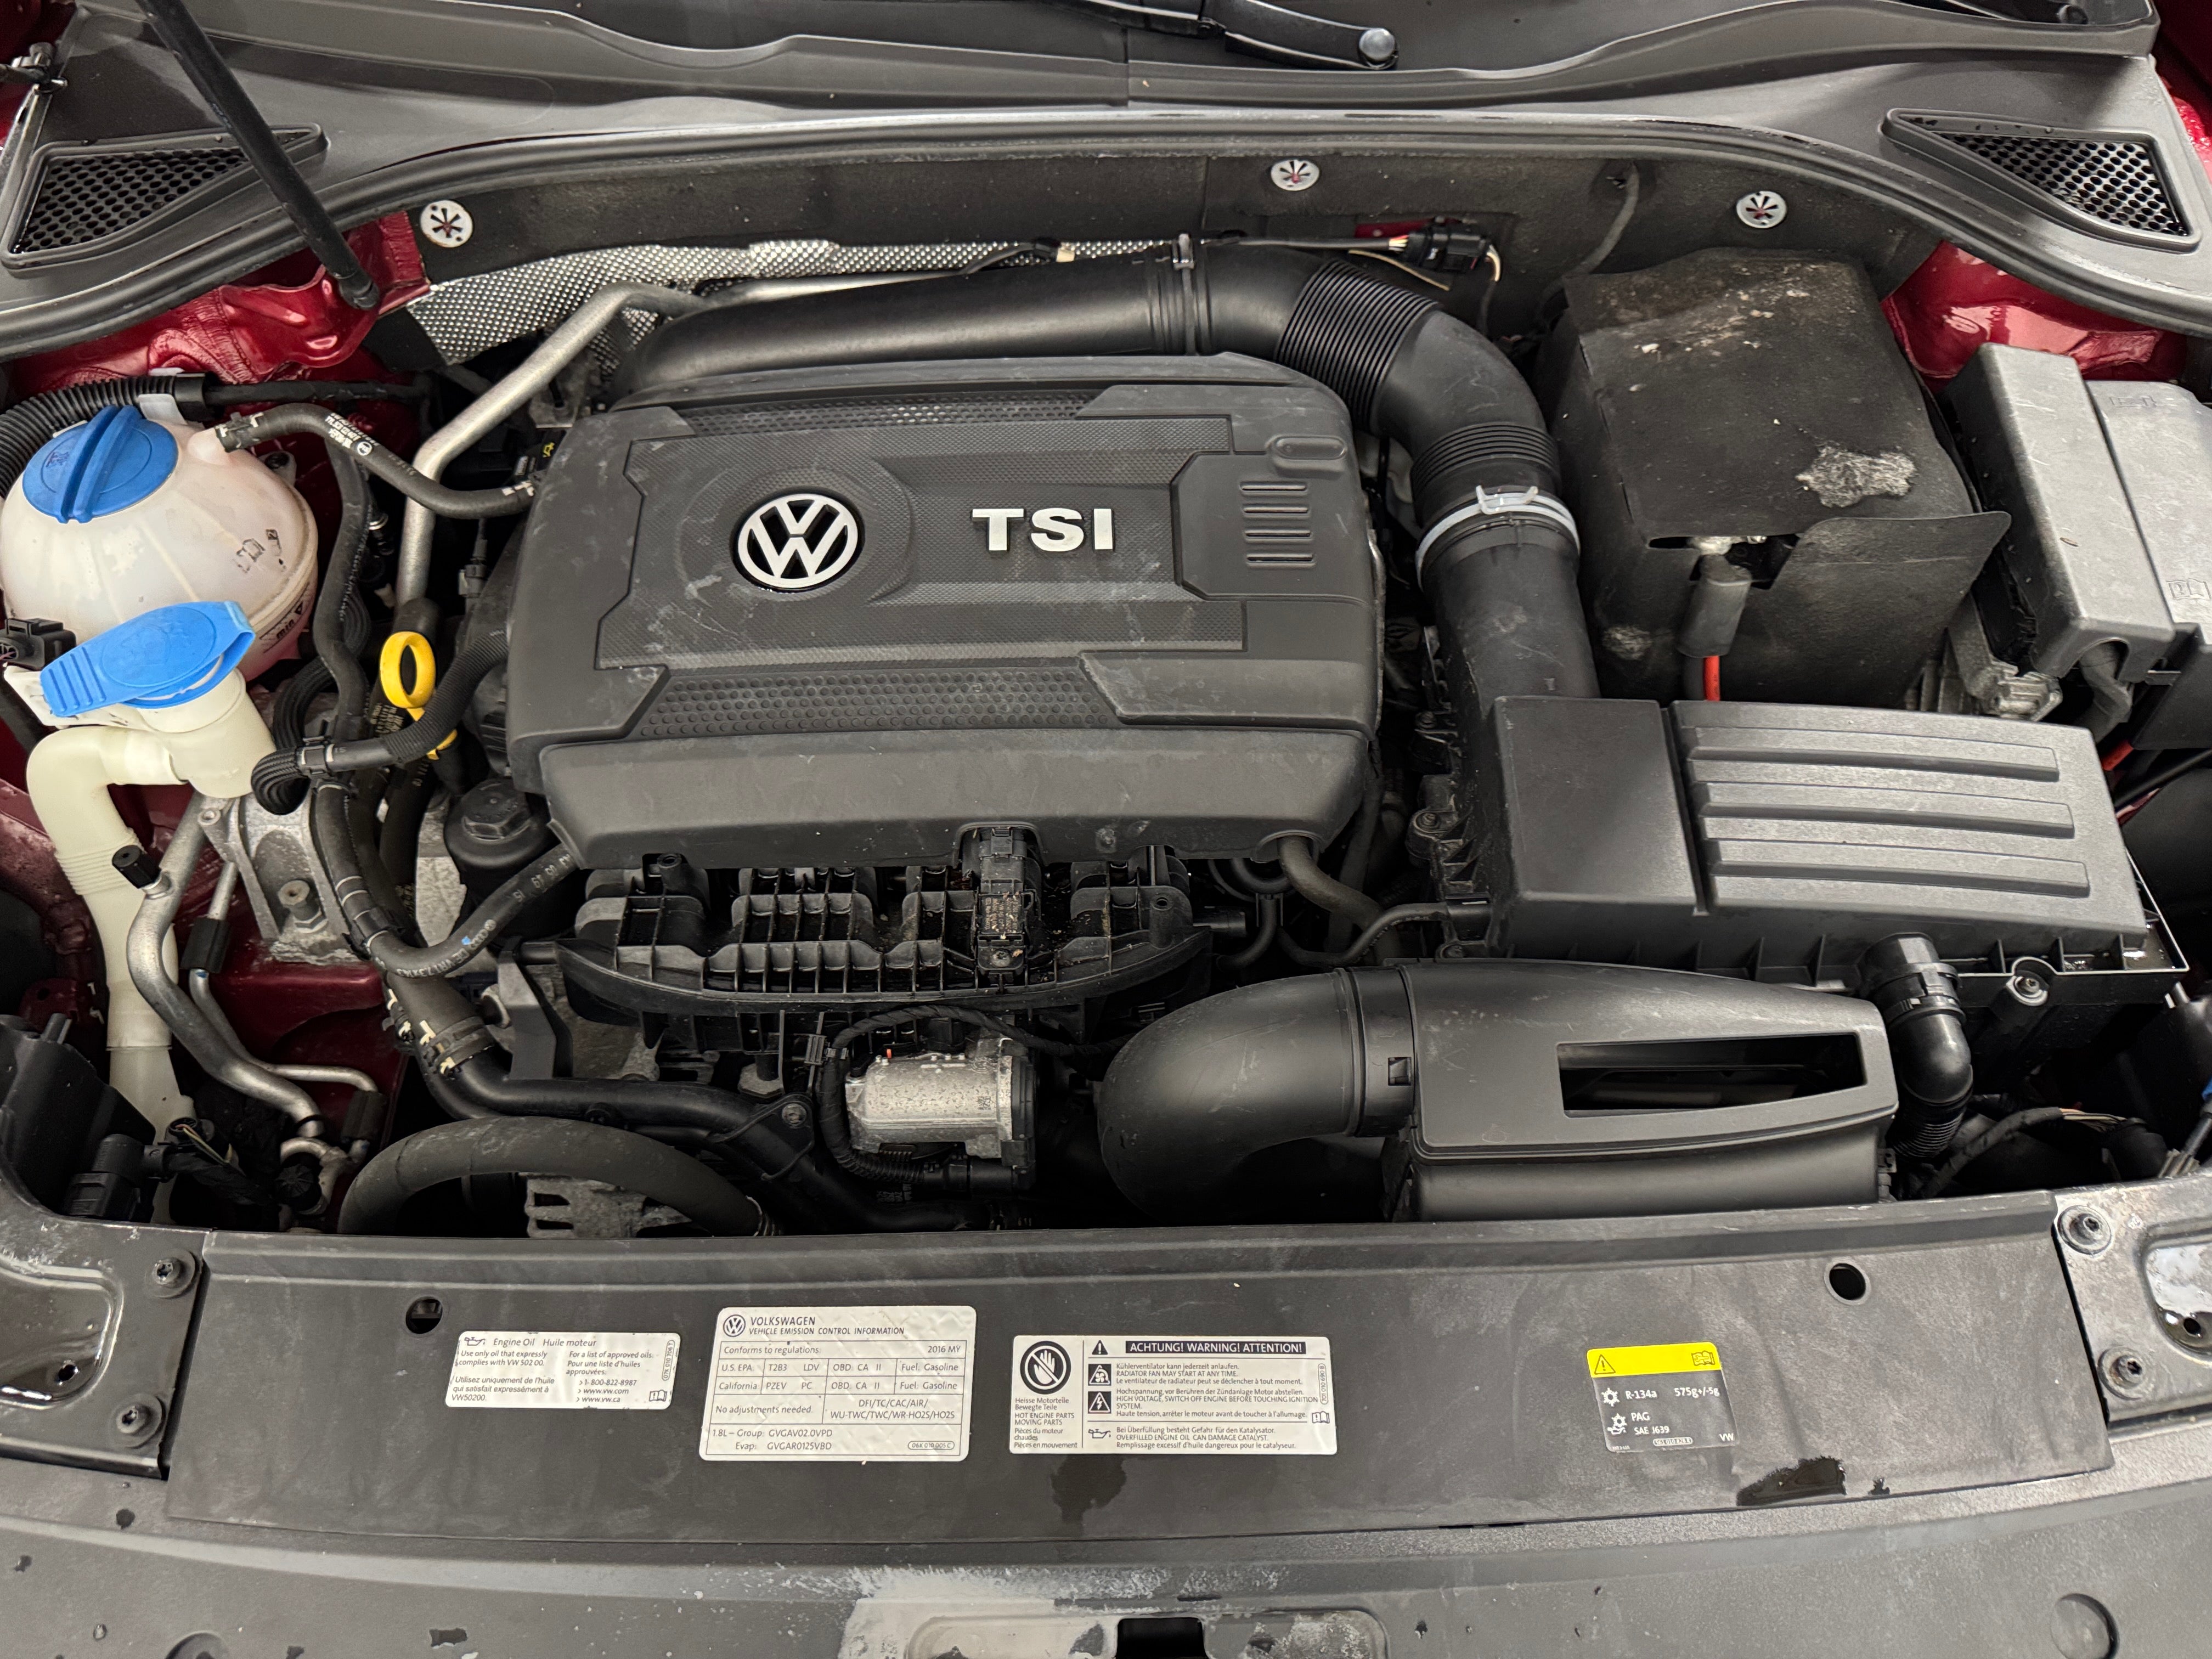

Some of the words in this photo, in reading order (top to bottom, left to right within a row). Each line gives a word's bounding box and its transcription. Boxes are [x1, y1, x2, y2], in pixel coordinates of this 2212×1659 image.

[972, 508, 1115, 553] TSI
[751, 1317, 815, 1325] VOLKSWAGEN
[493, 1338, 521, 1348] Engine
[1130, 1342, 1183, 1352] ACHTUNG!
[1187, 1342, 1239, 1352] WARNING!
[1243, 1343, 1301, 1352] ATTENTION!
[1625, 1390, 1657, 1400] R-134a
[859, 1399, 928, 1408] DFI/TC/CAC/AIR/
[729, 1406, 779, 1415] adjustments
[1631, 1412, 1650, 1421] PAG
[713, 1429, 727, 1437] 1.8L
[1127, 1425, 1165, 1435] Überfüllung
[1634, 1426, 1649, 1435] SAE
[1719, 1433, 1735, 1442] VW
[1204, 1442, 1238, 1450] dangereux
